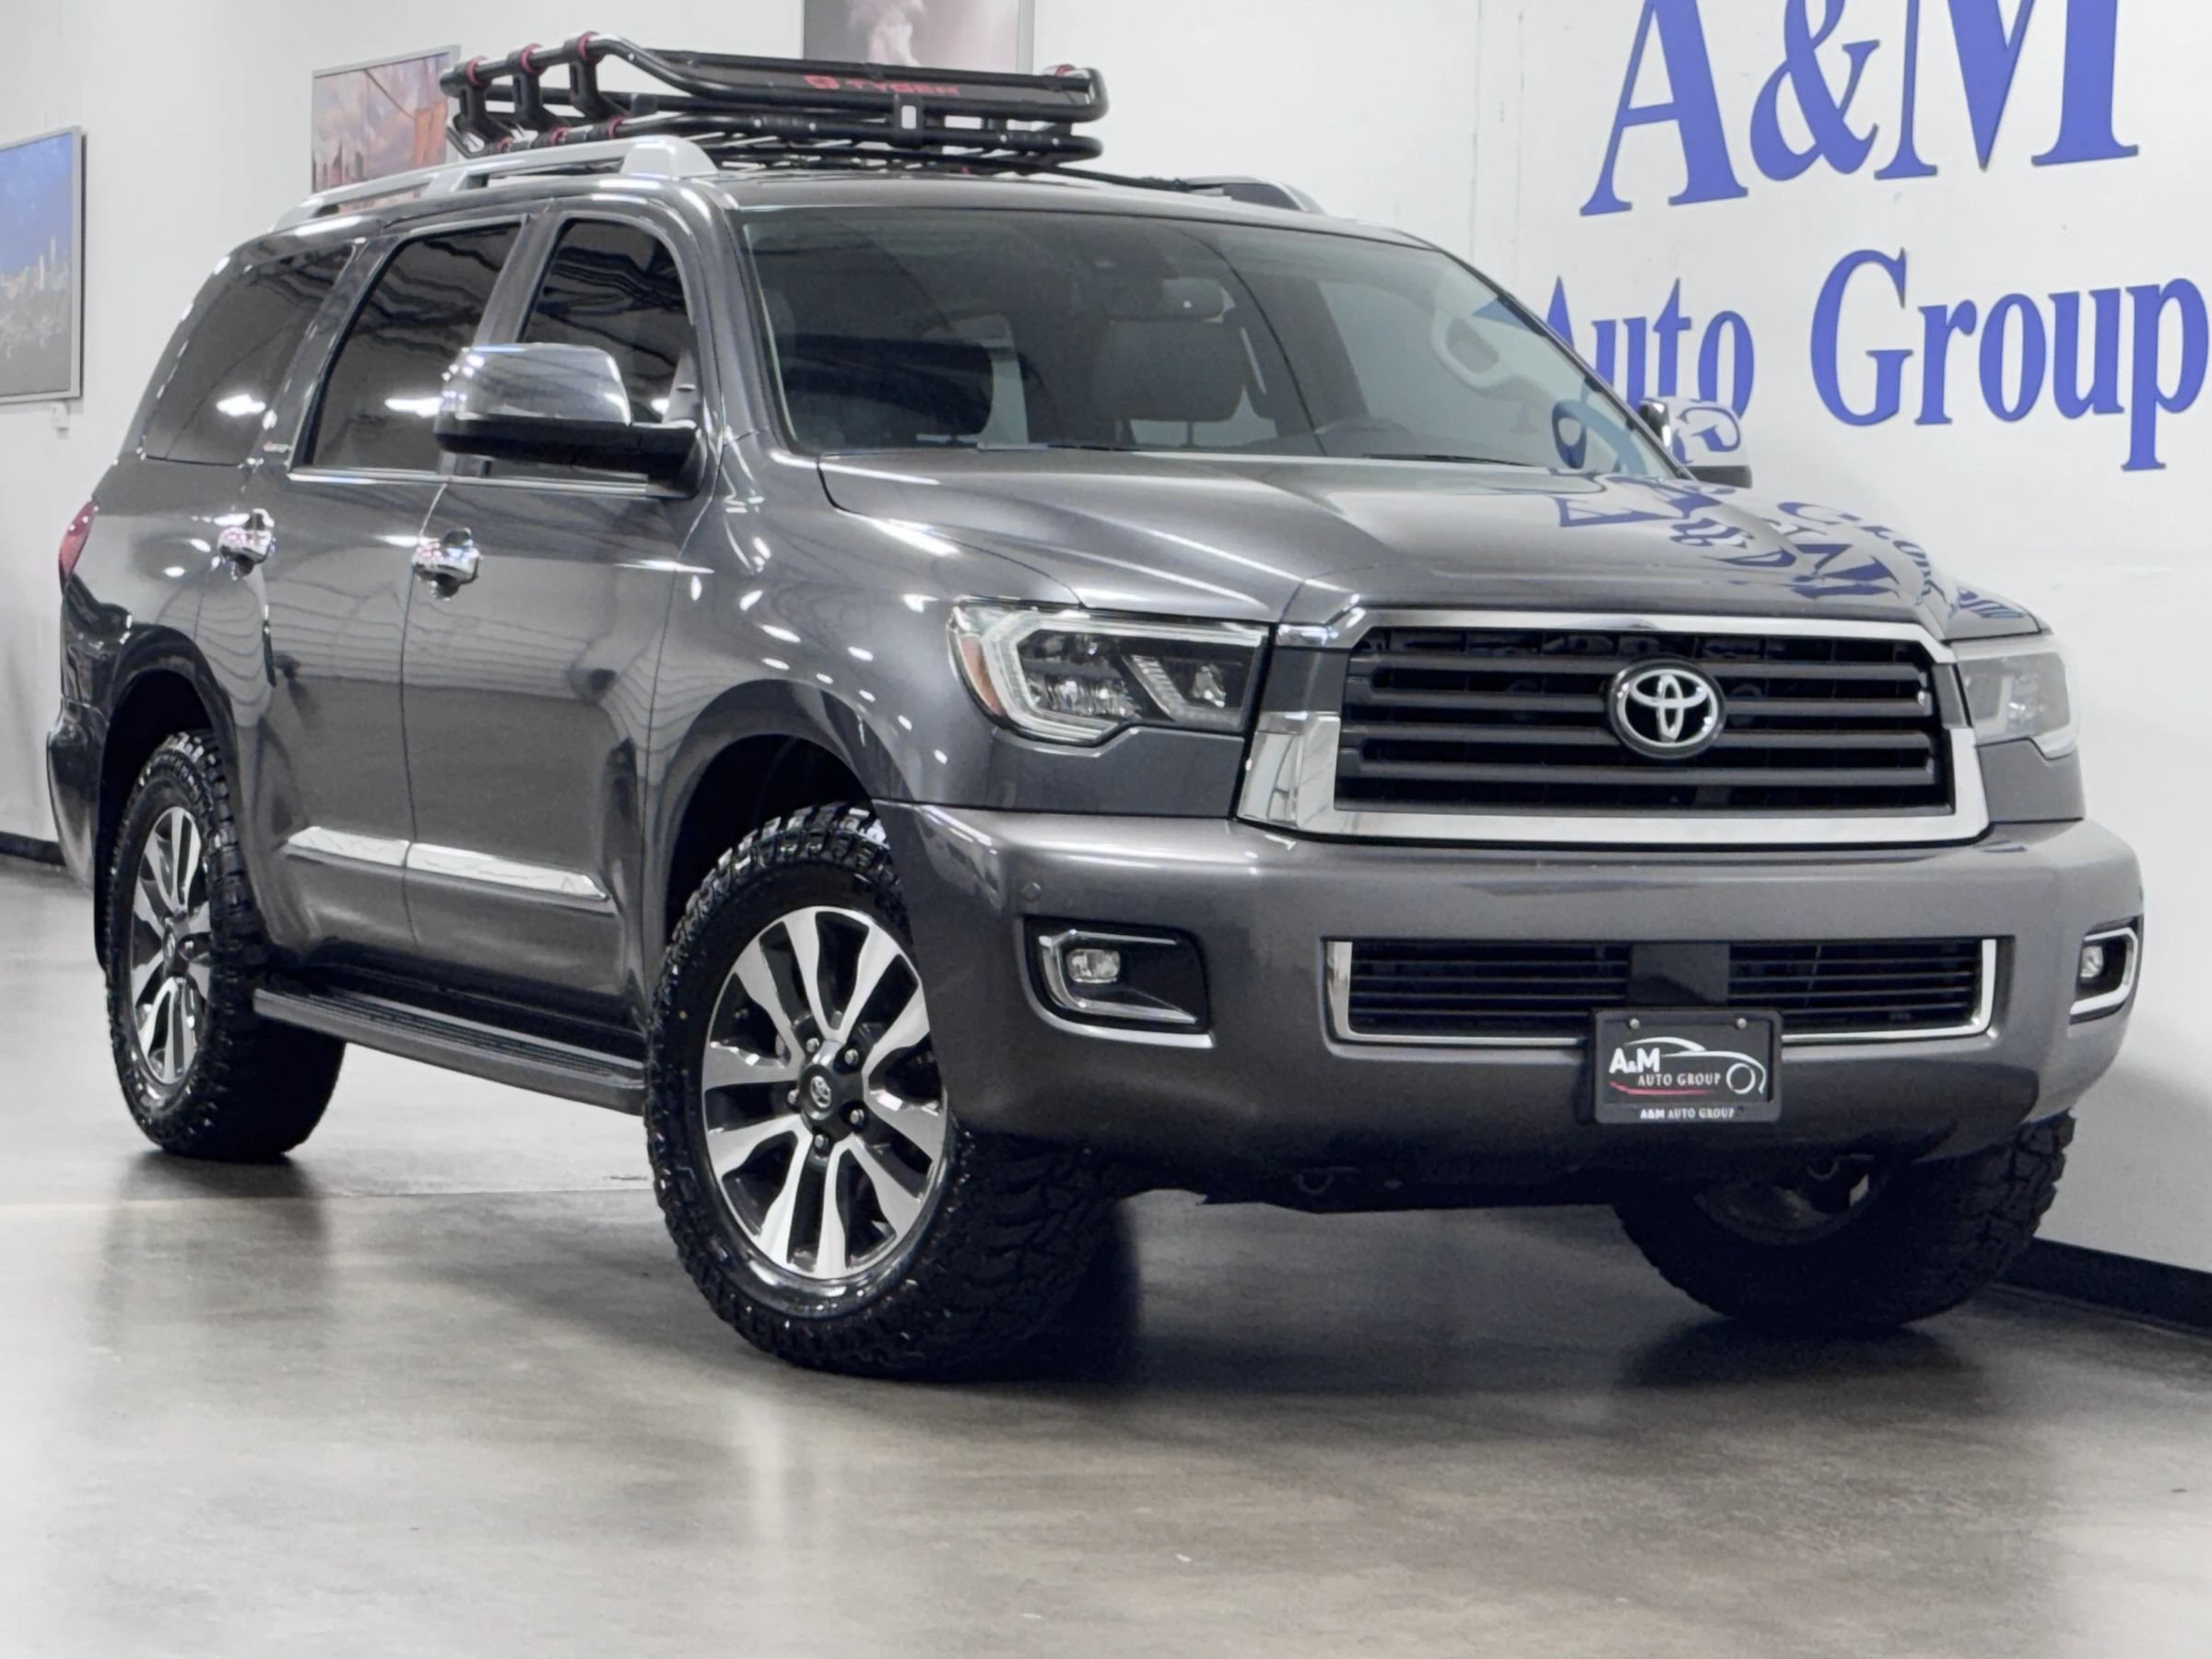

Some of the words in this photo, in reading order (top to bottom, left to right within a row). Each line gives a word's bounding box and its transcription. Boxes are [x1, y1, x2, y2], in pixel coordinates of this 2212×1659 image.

[1580, 0, 2138, 217] A&M
[1810, 247, 2209, 471] Group
[1608, 1047, 1661, 1074] A&M
[1637, 1073, 1673, 1087] AUTO
[1677, 1073, 1722, 1086] GROUP
[1640, 1108, 1665, 1120] A&M
[1667, 1108, 1695, 1120] AUTO
[1699, 1107, 1735, 1119] GROUP
